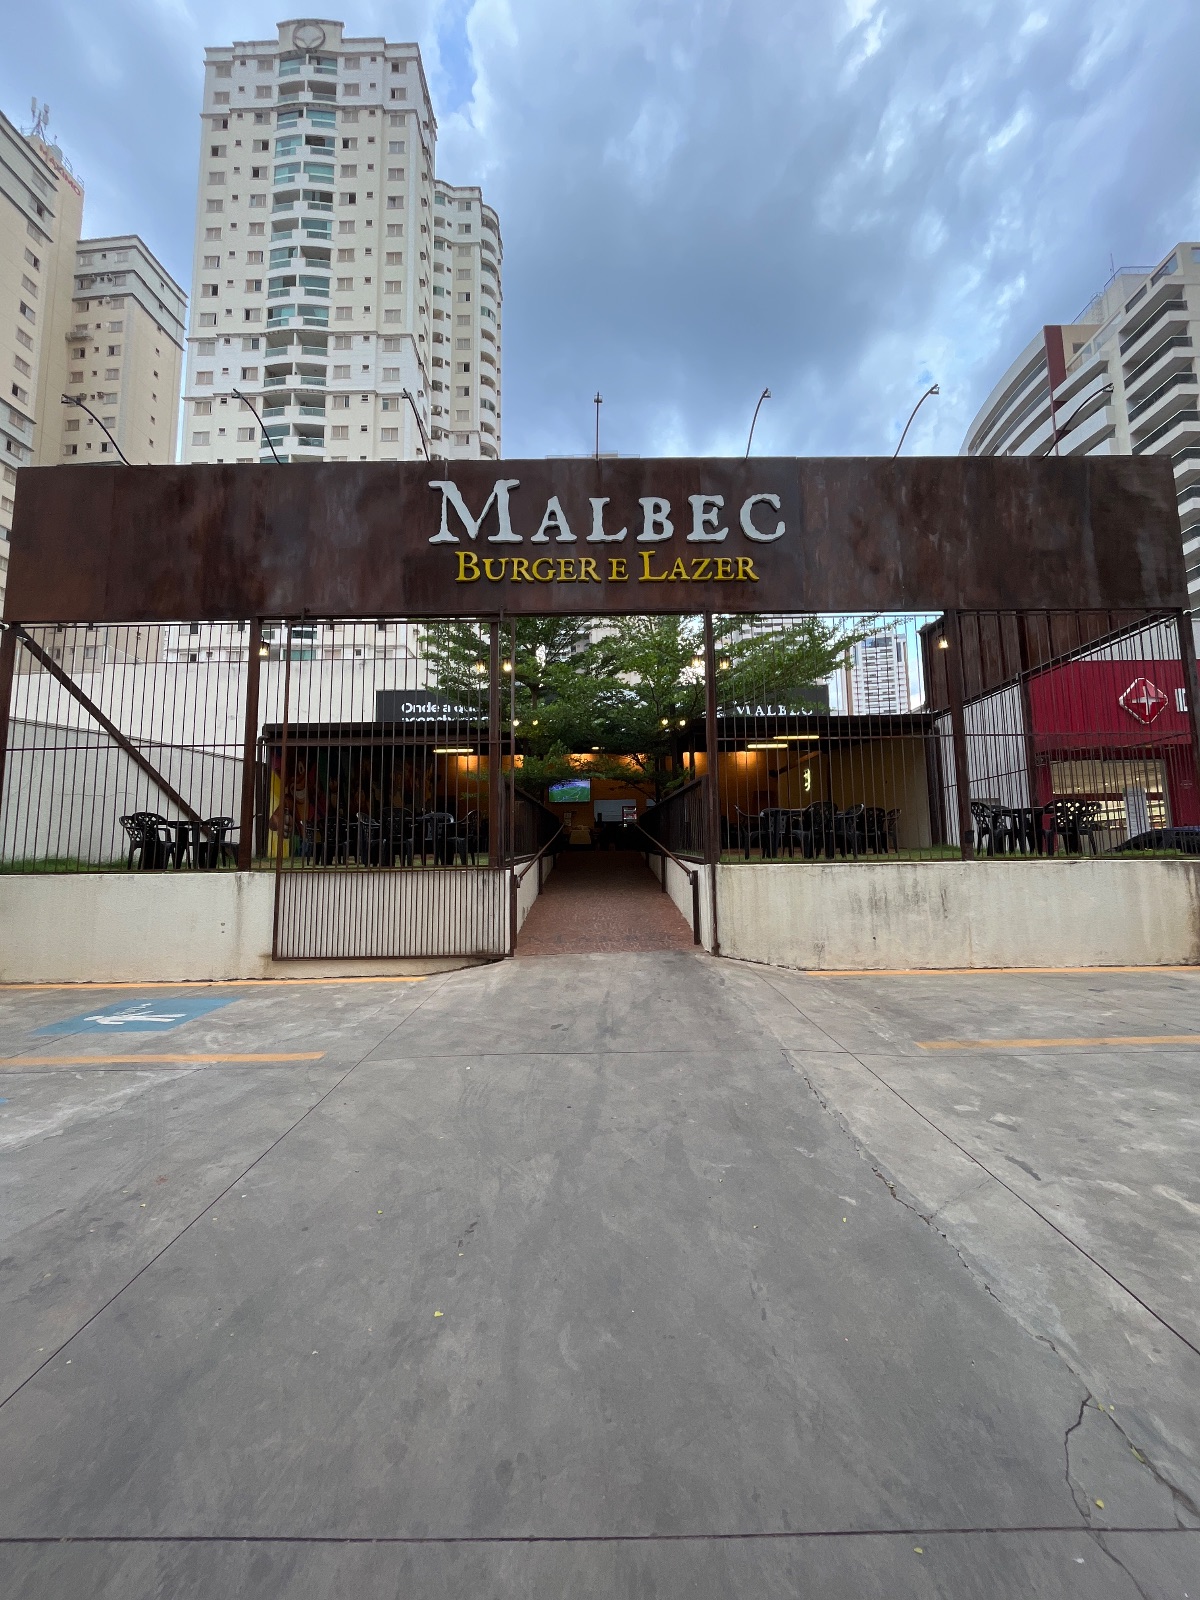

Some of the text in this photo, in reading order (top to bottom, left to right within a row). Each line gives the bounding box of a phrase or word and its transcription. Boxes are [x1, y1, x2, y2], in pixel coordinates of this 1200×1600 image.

[428, 479, 786, 544] MALBEC
[455, 550, 760, 583] BURGER E LAZER
[401, 702, 440, 713] Onde
